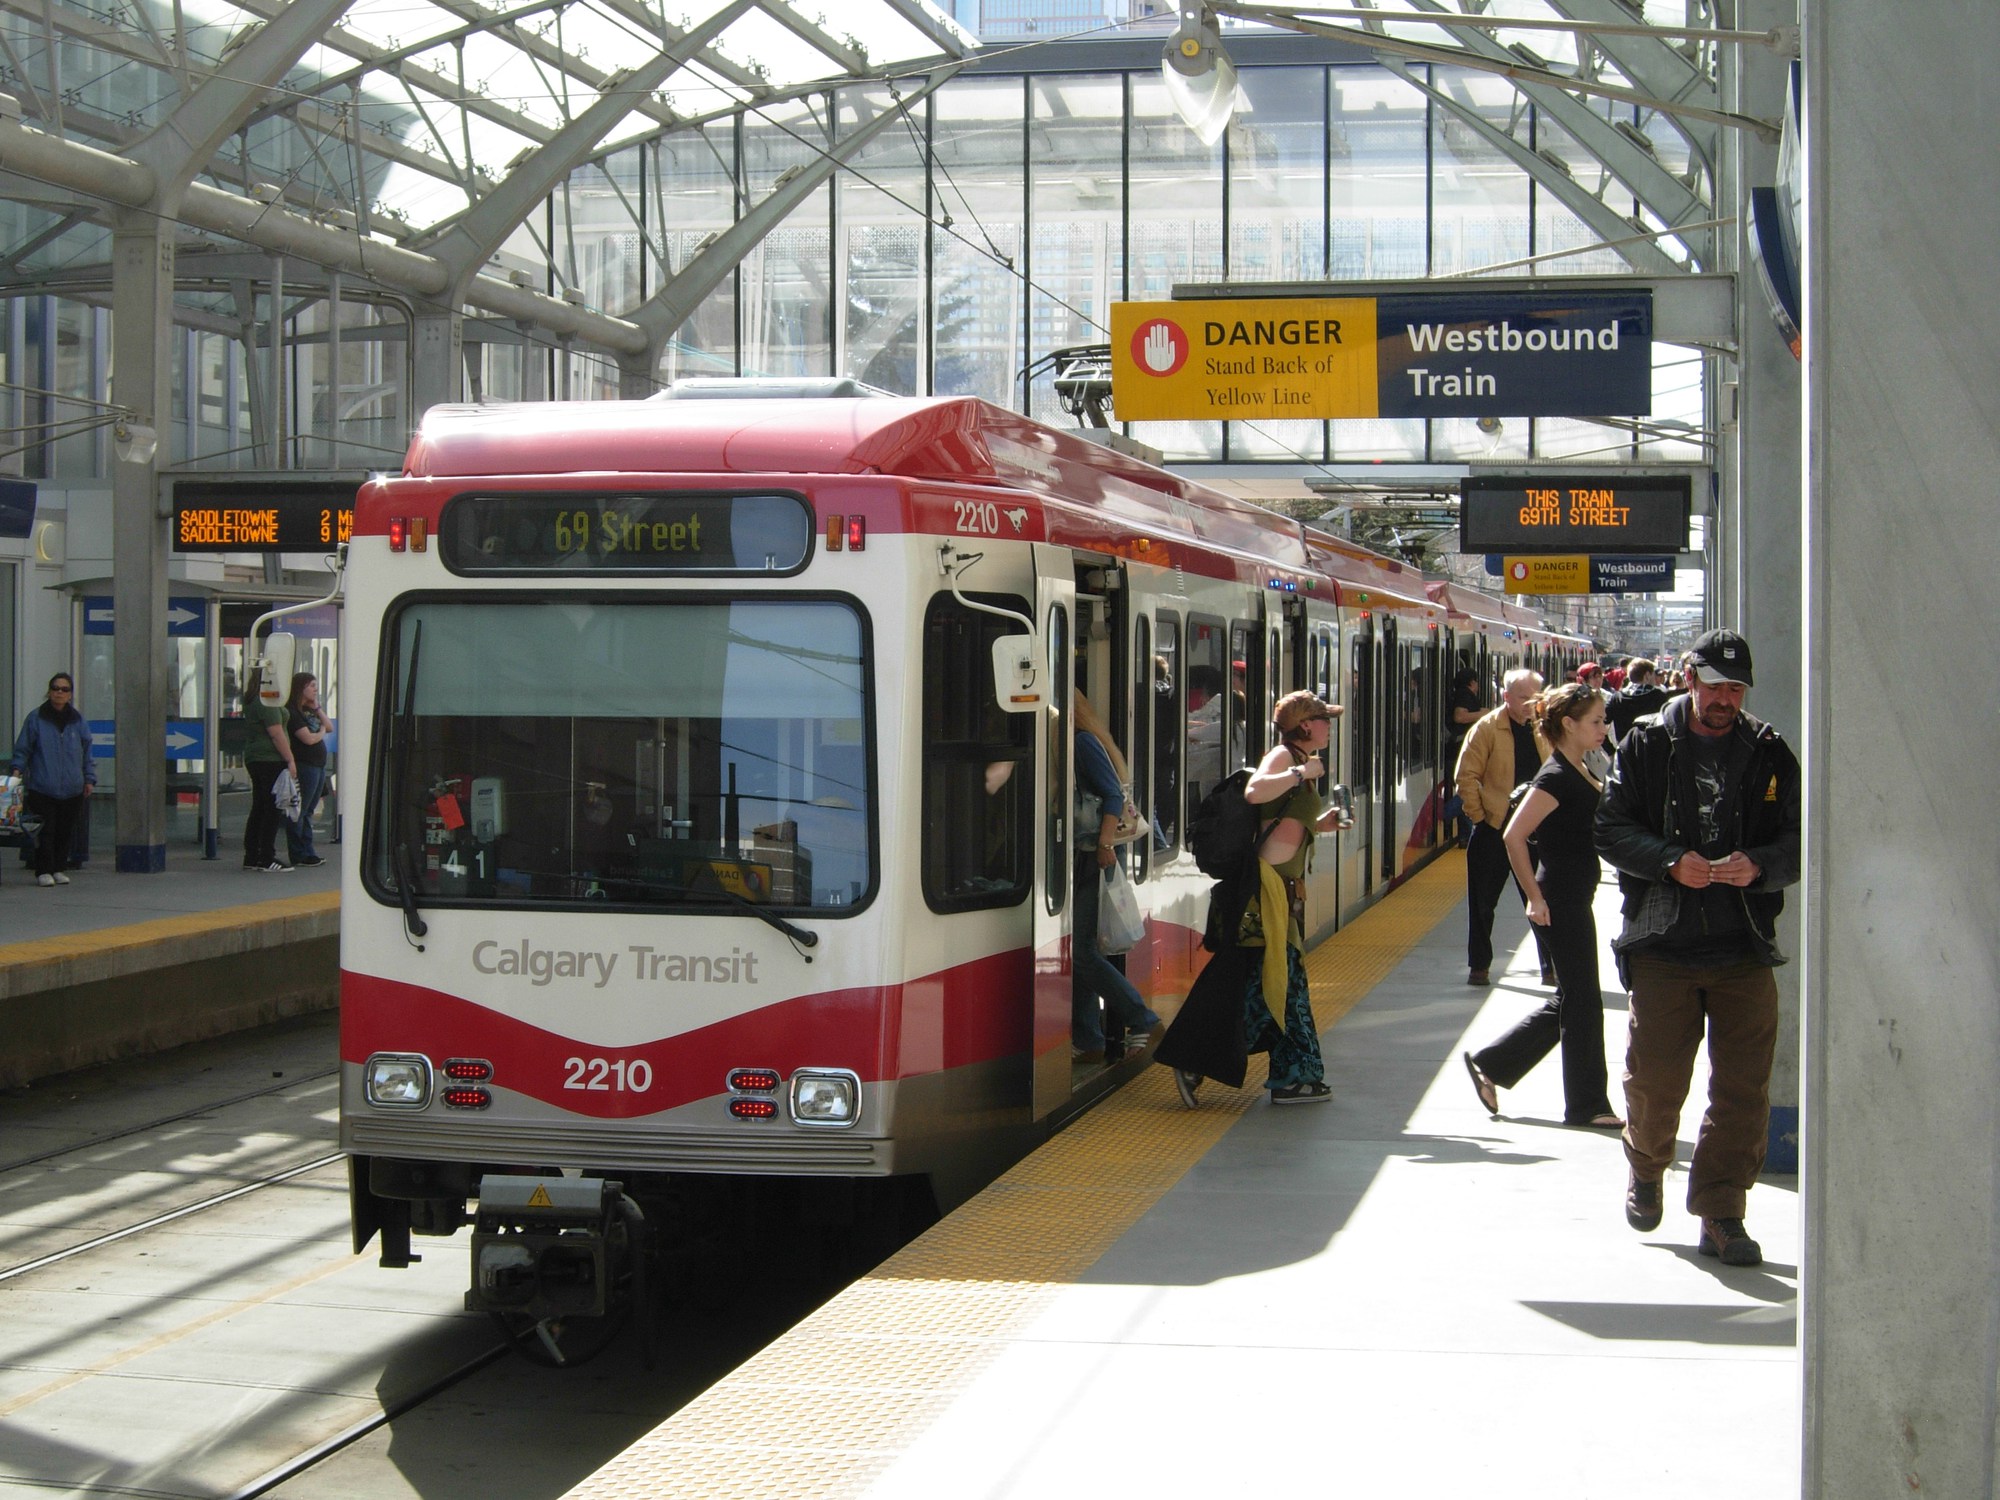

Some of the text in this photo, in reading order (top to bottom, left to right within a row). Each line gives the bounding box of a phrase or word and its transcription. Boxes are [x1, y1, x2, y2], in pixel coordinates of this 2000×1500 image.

[1204, 319, 1343, 346] DANGER
[1406, 320, 1620, 352] Westbound
[1205, 354, 1334, 375] Stand Back of
[1406, 367, 1497, 396] Train
[1206, 387, 1312, 406] Yellow Line
[1525, 489, 1614, 508] THIS TRAIN
[180, 509, 279, 526] SADDLETOWNE
[320, 509, 331, 526] 2
[954, 500, 999, 534] 2210
[1519, 507, 1631, 526] 69TH STREET
[180, 526, 279, 543] SADDLETOWNE
[320, 526, 331, 543] 9
[555, 510, 701, 551] 69 Street
[1533, 561, 1579, 571] DANGER
[1598, 562, 1666, 574] Westbound
[1598, 576, 1628, 588] Train
[472, 938, 759, 989] Calgary Transit
[563, 1056, 653, 1093] 2210
